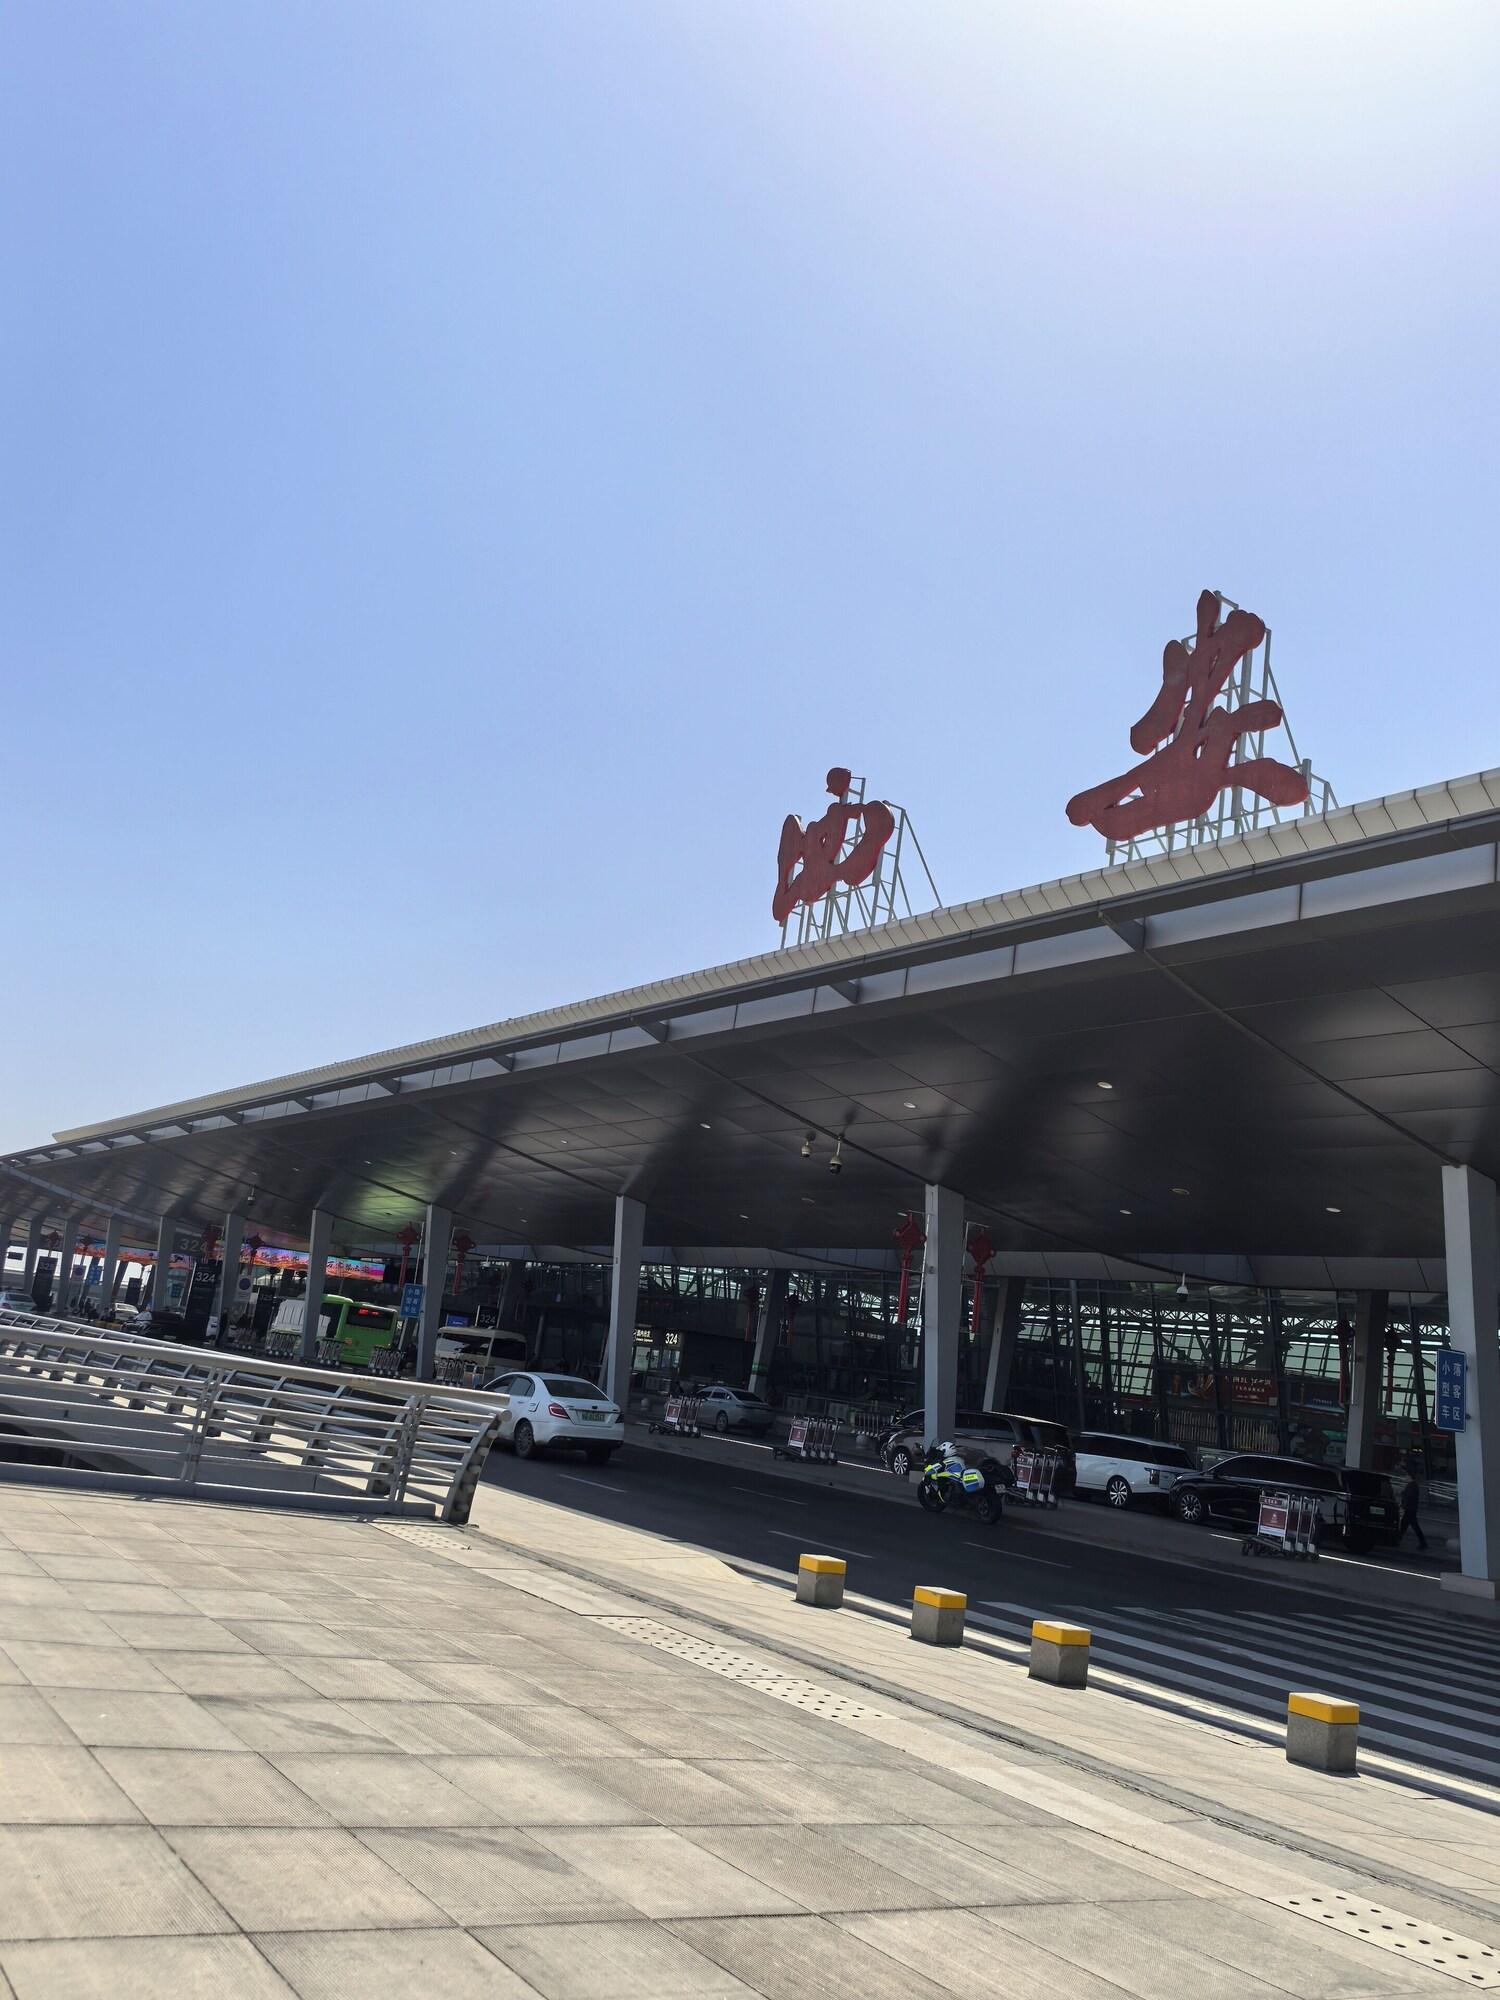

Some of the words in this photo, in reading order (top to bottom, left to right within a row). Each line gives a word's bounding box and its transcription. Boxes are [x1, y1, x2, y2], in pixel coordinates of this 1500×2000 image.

[195, 1271, 216, 1283] 324
[479, 1314, 496, 1325] 324
[665, 1332, 678, 1344] 324
[1441, 1360, 1451, 1419] 小型车
[1452, 1362, 1462, 1421] 落客区
